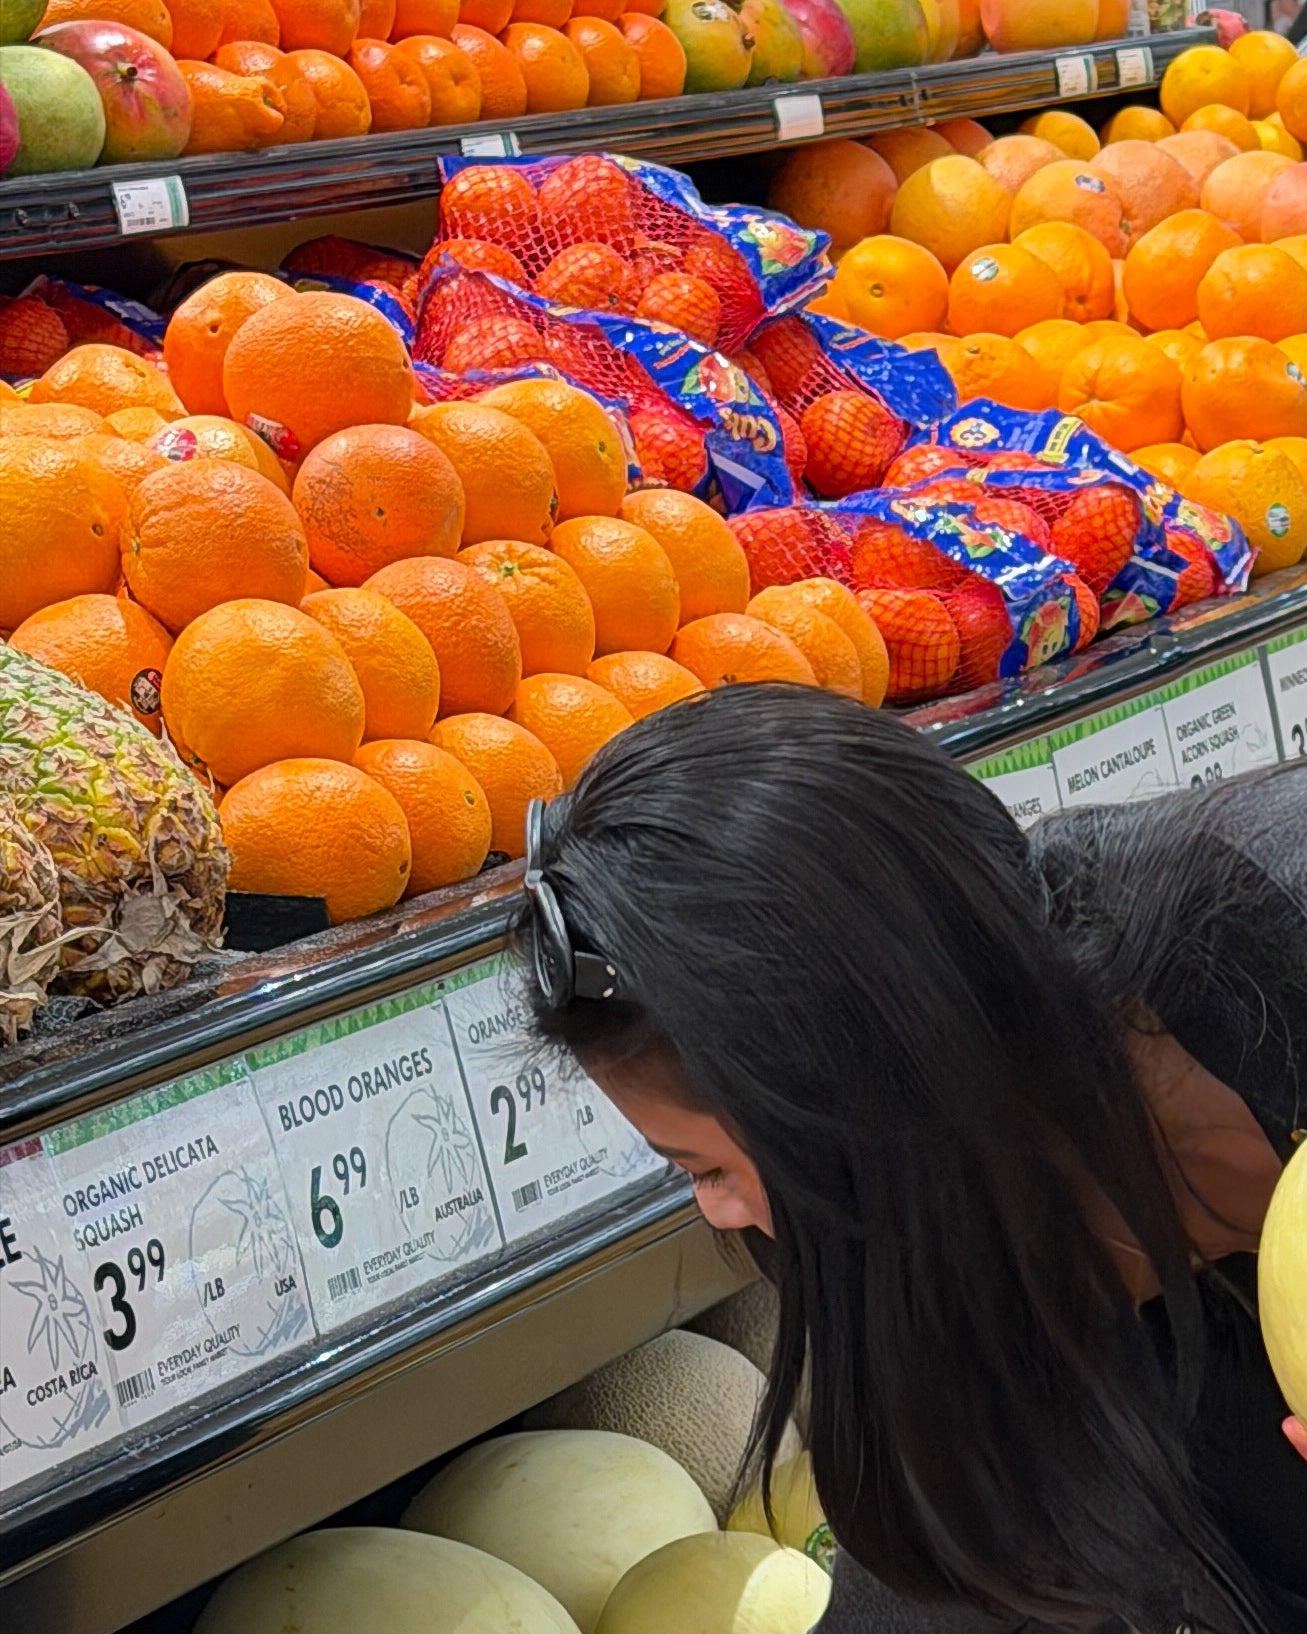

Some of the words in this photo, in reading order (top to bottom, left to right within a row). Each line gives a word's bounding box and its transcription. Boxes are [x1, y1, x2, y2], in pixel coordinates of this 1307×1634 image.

[1176, 713, 1212, 742] ORGANIC
[1212, 702, 1237, 724] GREEN
[1066, 764, 1100, 795] MELON
[1100, 738, 1157, 778] CANTALOUPE
[1181, 740, 1209, 765] ACORN
[278, 1084, 344, 1132] BLOOD
[347, 1048, 433, 1103] ORANGES
[62, 1166, 143, 1217] ORGANIC
[143, 1134, 220, 1184] DELICATA
[73, 1204, 144, 1252] SQUASH
[435, 1188, 484, 1222] AUSTRALIA
[363, 1247, 401, 1275] EVERYDAY
[402, 1230, 436, 1257] QUALITY
[94, 1238, 165, 1351] 399
[203, 1277, 226, 1307] /LB
[274, 1274, 297, 1297] USA
[157, 1343, 202, 1376] EVERYDAY
[203, 1323, 240, 1353] QUALITY
[26, 1374, 69, 1406] COSTA
[69, 1360, 98, 1387] RICA
